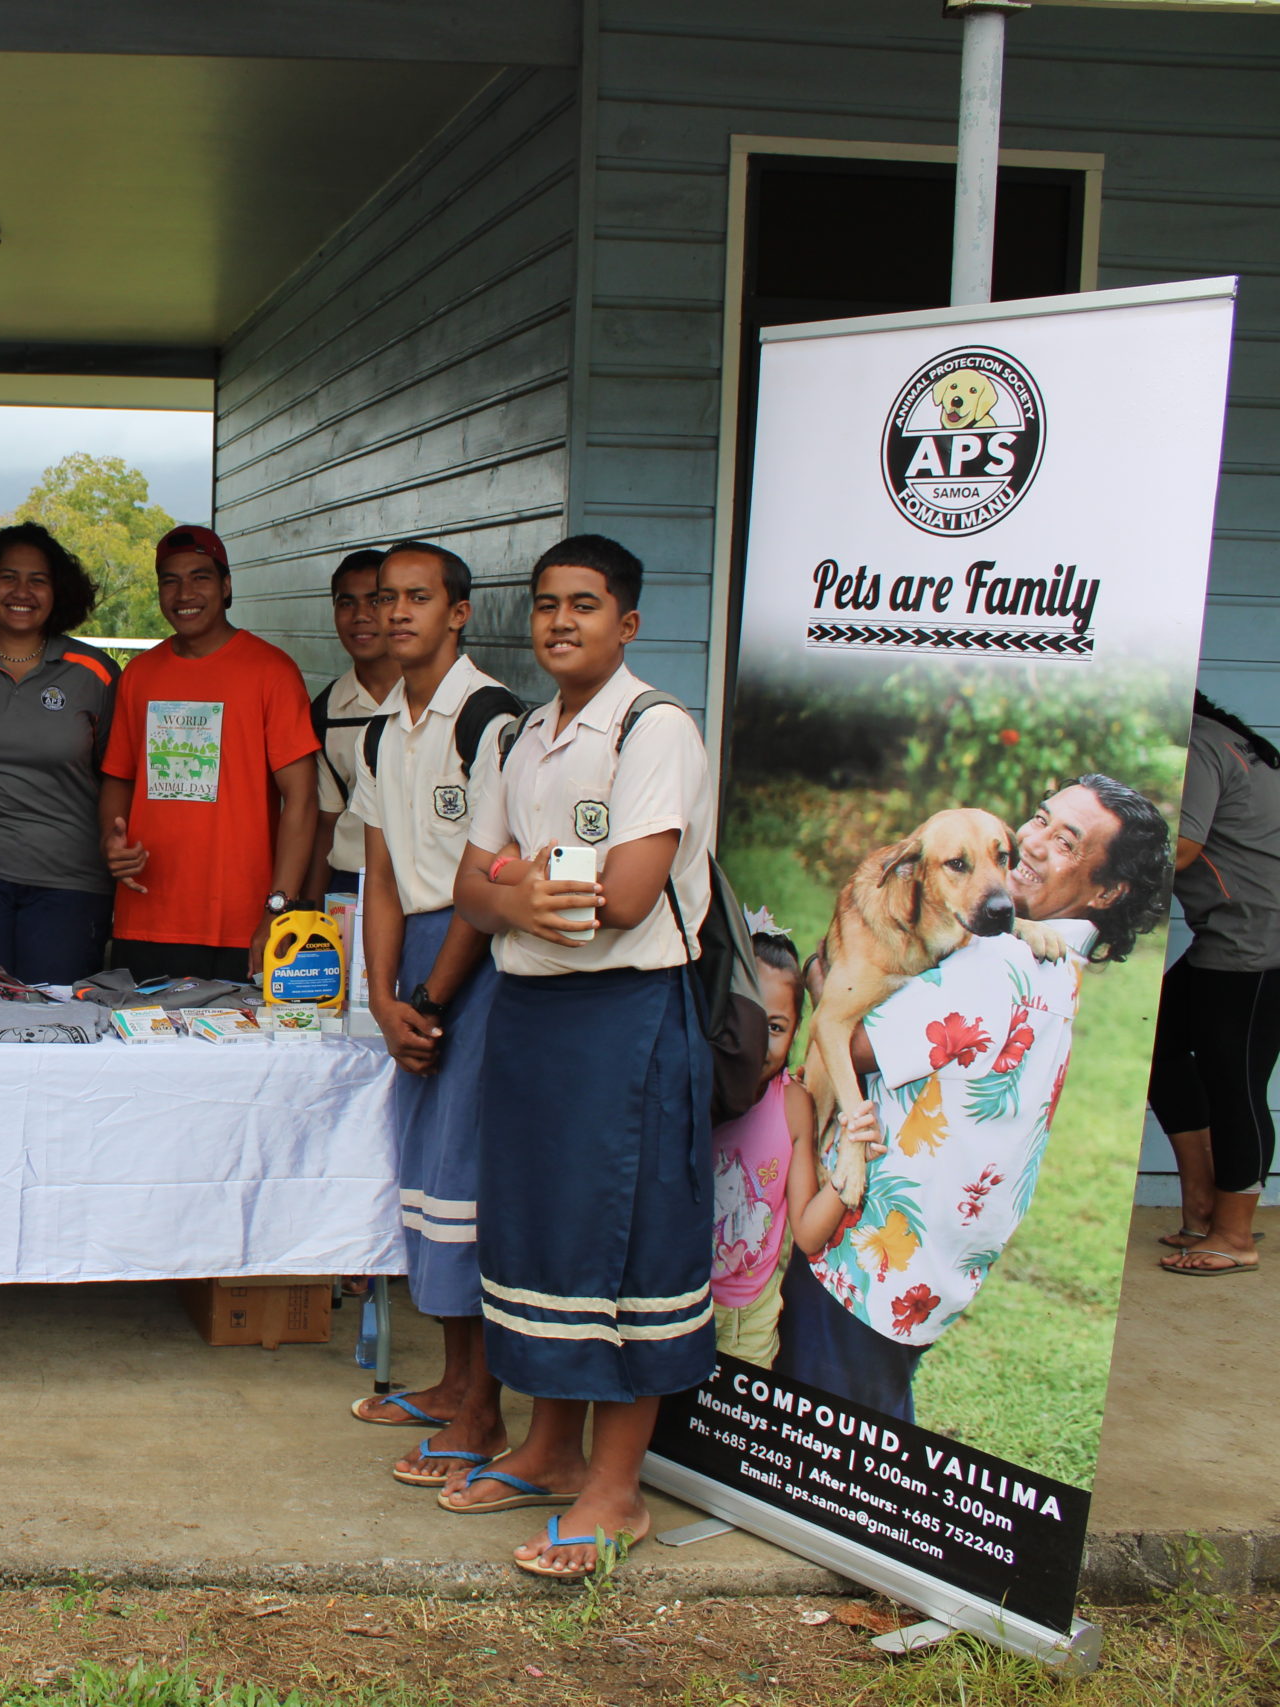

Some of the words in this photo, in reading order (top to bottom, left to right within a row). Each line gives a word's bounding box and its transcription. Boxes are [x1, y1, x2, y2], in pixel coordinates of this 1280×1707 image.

[896, 377, 930, 428] ANIMAL
[929, 357, 1003, 380] PROTECTION
[1002, 368, 1035, 420] SOCIETY
[904, 432, 1018, 477] APS
[898, 488, 955, 529] FOMA'I
[960, 486, 1015, 529] MANU
[932, 487, 980, 499] SAMOA
[812, 558, 881, 611] Pets
[888, 571, 954, 614] are
[964, 560, 1101, 634] Family
[163, 715, 208, 727] WORLD
[149, 782, 187, 792] ANIMAL
[189, 783, 213, 793] DAY
[274, 968, 318, 977] PANACUR
[323, 967, 340, 975] 100
[697, 1389, 768, 1431] Mondays
[781, 1422, 841, 1461] Fridays
[863, 1456, 928, 1497] 9.00am
[942, 1488, 1014, 1532] 3.00pm
[733, 1373, 910, 1461] COMPOUND,
[925, 1445, 1062, 1521] VAILIMA
[689, 1416, 710, 1436] Ph:
[713, 1429, 748, 1450] +685
[749, 1442, 793, 1470] 22403
[808, 1467, 847, 1493] After
[848, 1483, 897, 1515] Hours:
[901, 1507, 941, 1533] +685
[945, 1522, 1016, 1565] 7522403
[740, 1460, 783, 1489] Email:
[785, 1482, 944, 1560] aps.samoa@gmail.com
